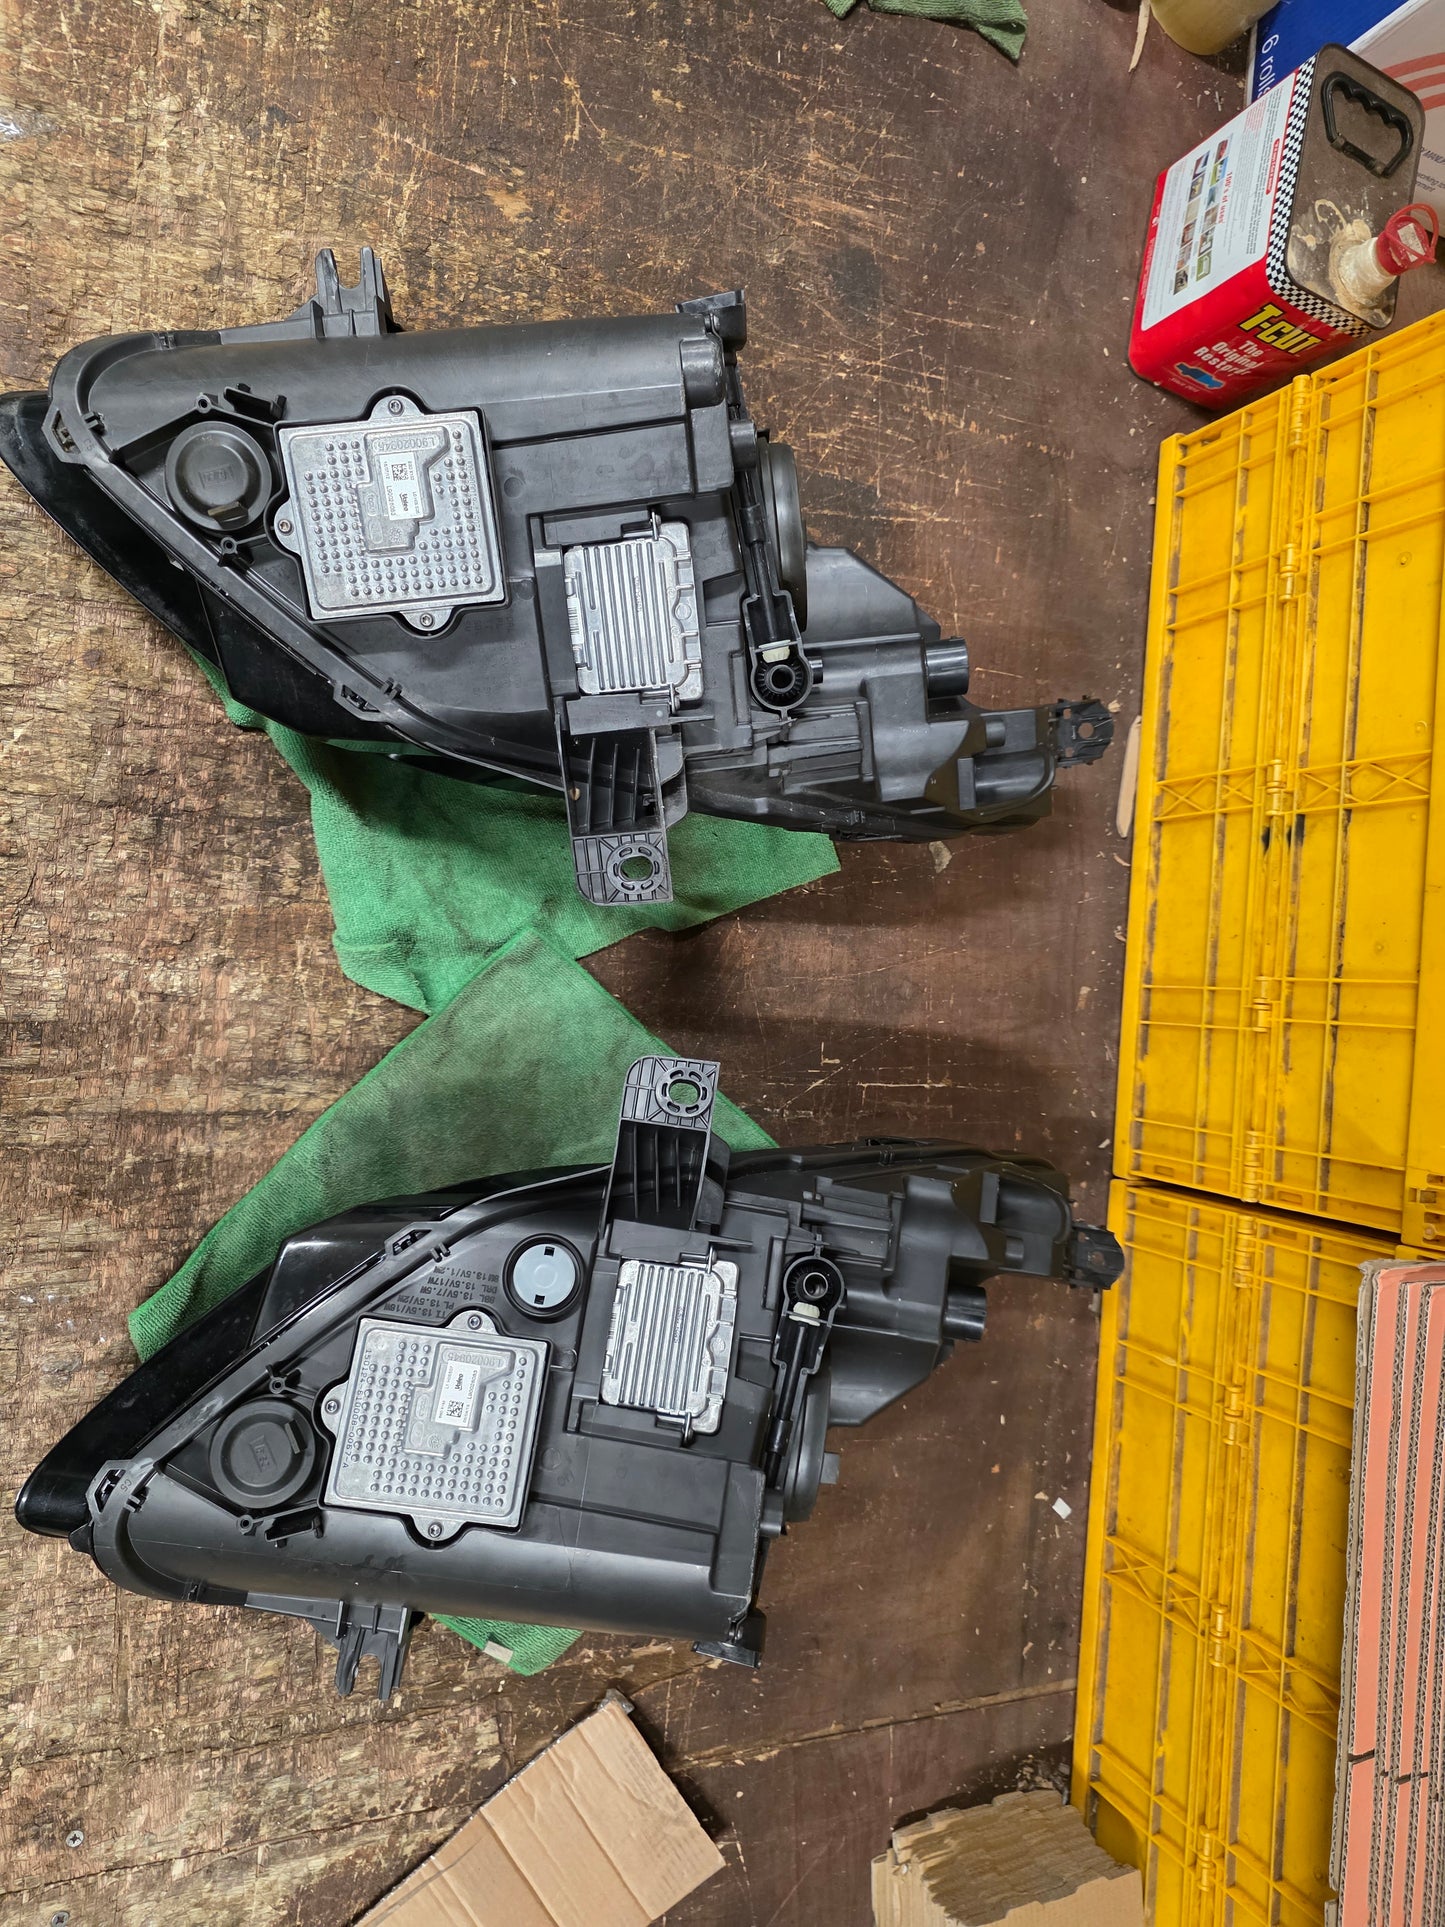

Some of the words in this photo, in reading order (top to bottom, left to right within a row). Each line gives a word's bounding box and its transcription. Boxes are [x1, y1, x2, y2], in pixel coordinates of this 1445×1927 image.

[1262, 34, 1280, 54] 6
[1238, 303, 1324, 354] T-CUT
[1212, 341, 1265, 369] Original
[1239, 340, 1264, 357] The
[427, 1276, 476, 1291] 13.5V/17W
[482, 1284, 498, 1294] DRL
[420, 1285, 474, 1300] 13.5V/7.5W
[396, 1294, 440, 1308] 13.5V/2W
[444, 1301, 454, 1310] PL
[383, 1302, 432, 1317] 13.5V/18W
